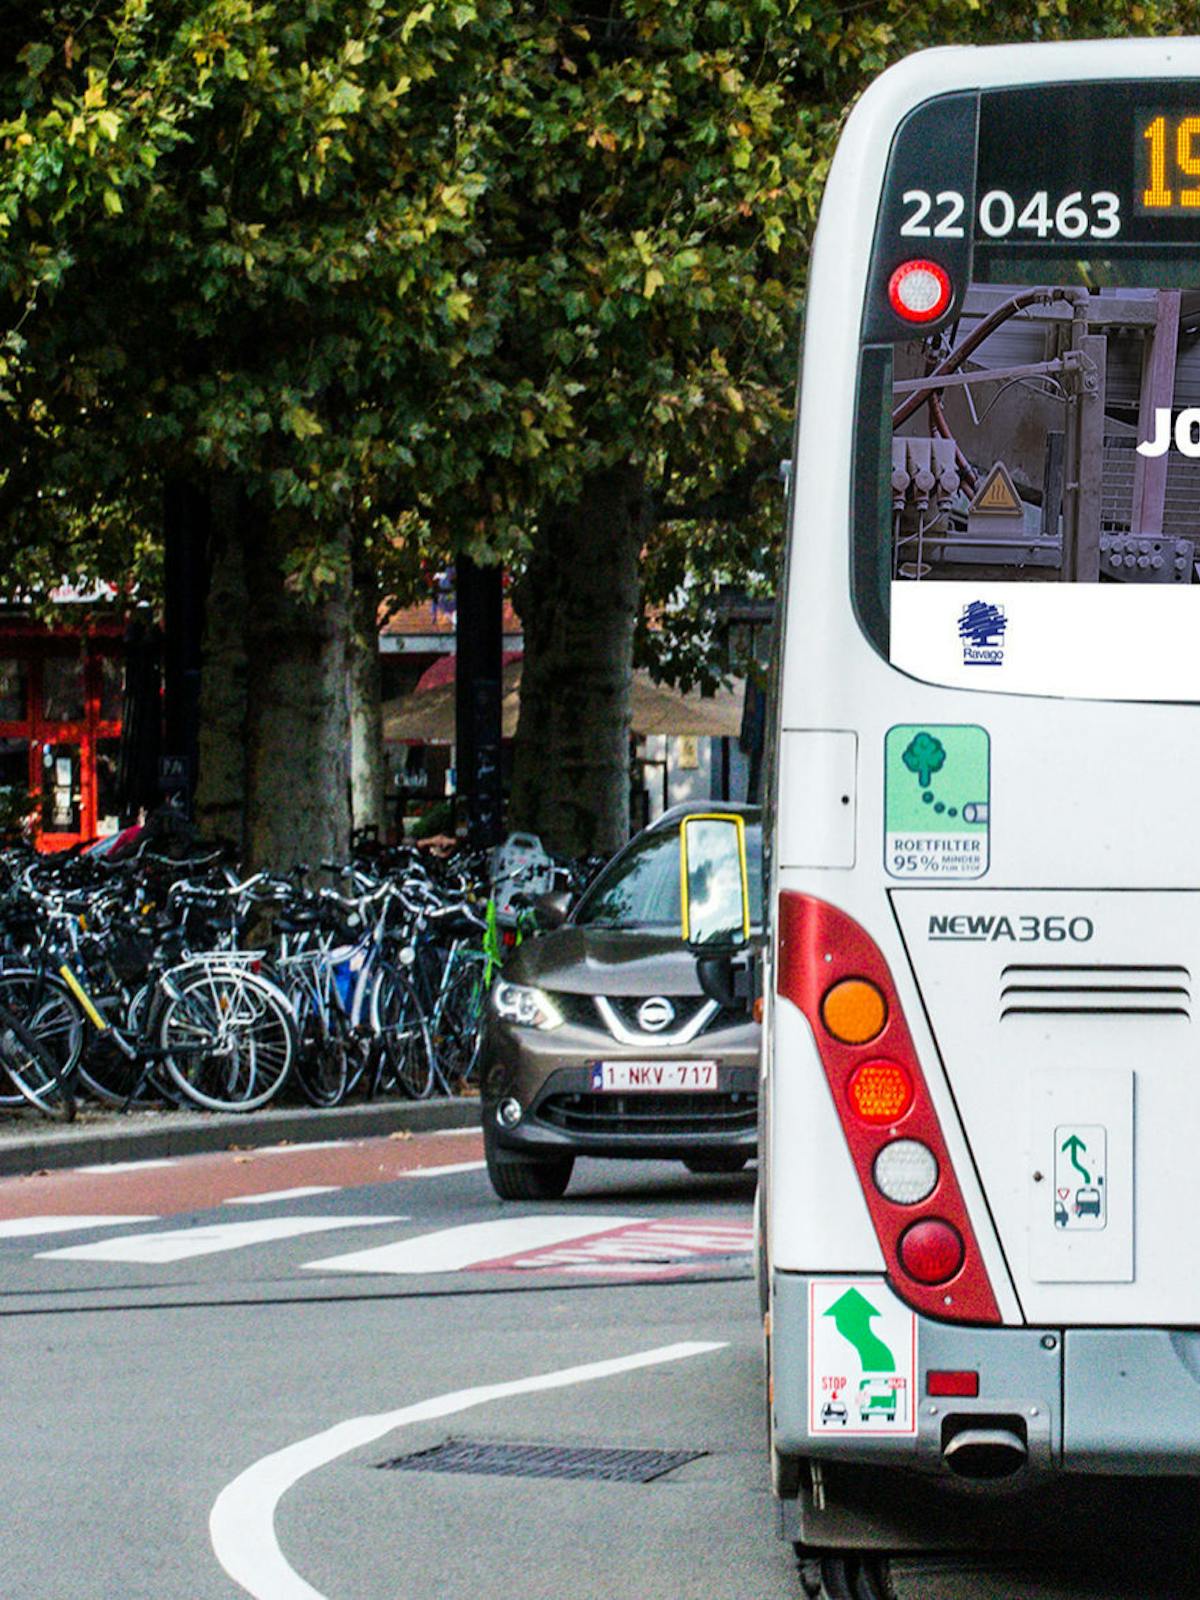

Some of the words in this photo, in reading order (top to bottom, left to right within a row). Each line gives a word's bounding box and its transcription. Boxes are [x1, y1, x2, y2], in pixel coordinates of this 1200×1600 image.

[899, 190, 965, 238] 22
[979, 191, 1121, 238] 0463
[963, 648, 1004, 663] Ravago
[894, 839, 980, 851] ROETFILTER
[822, 1376, 847, 1390] STOP
